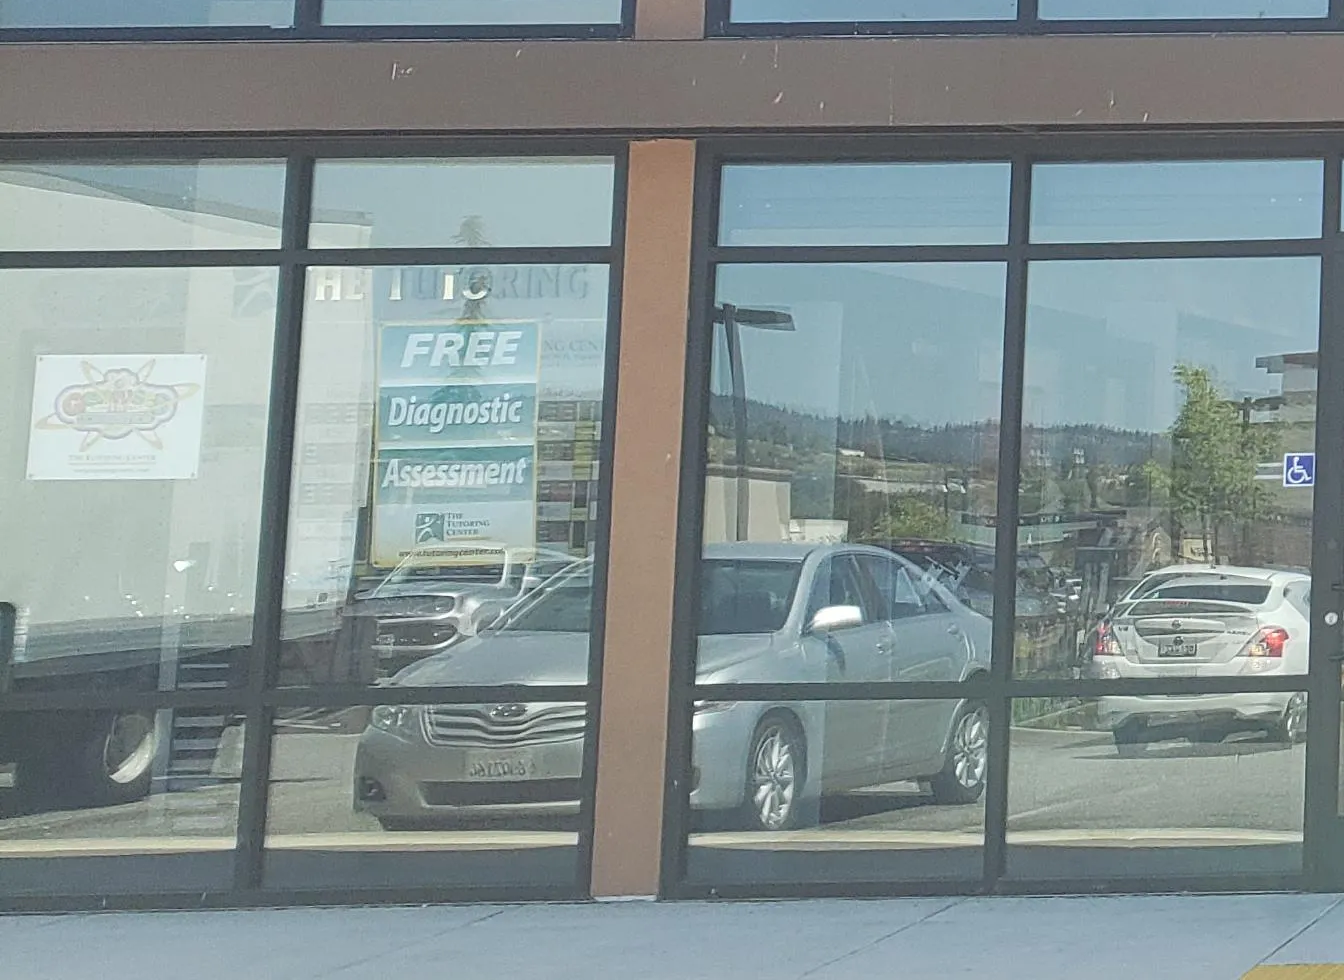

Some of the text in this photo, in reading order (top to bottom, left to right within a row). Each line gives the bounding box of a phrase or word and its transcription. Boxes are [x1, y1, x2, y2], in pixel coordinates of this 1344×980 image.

[400, 330, 523, 369] FREE
[387, 393, 524, 433] Diagnostic
[380, 457, 529, 488] Assessment
